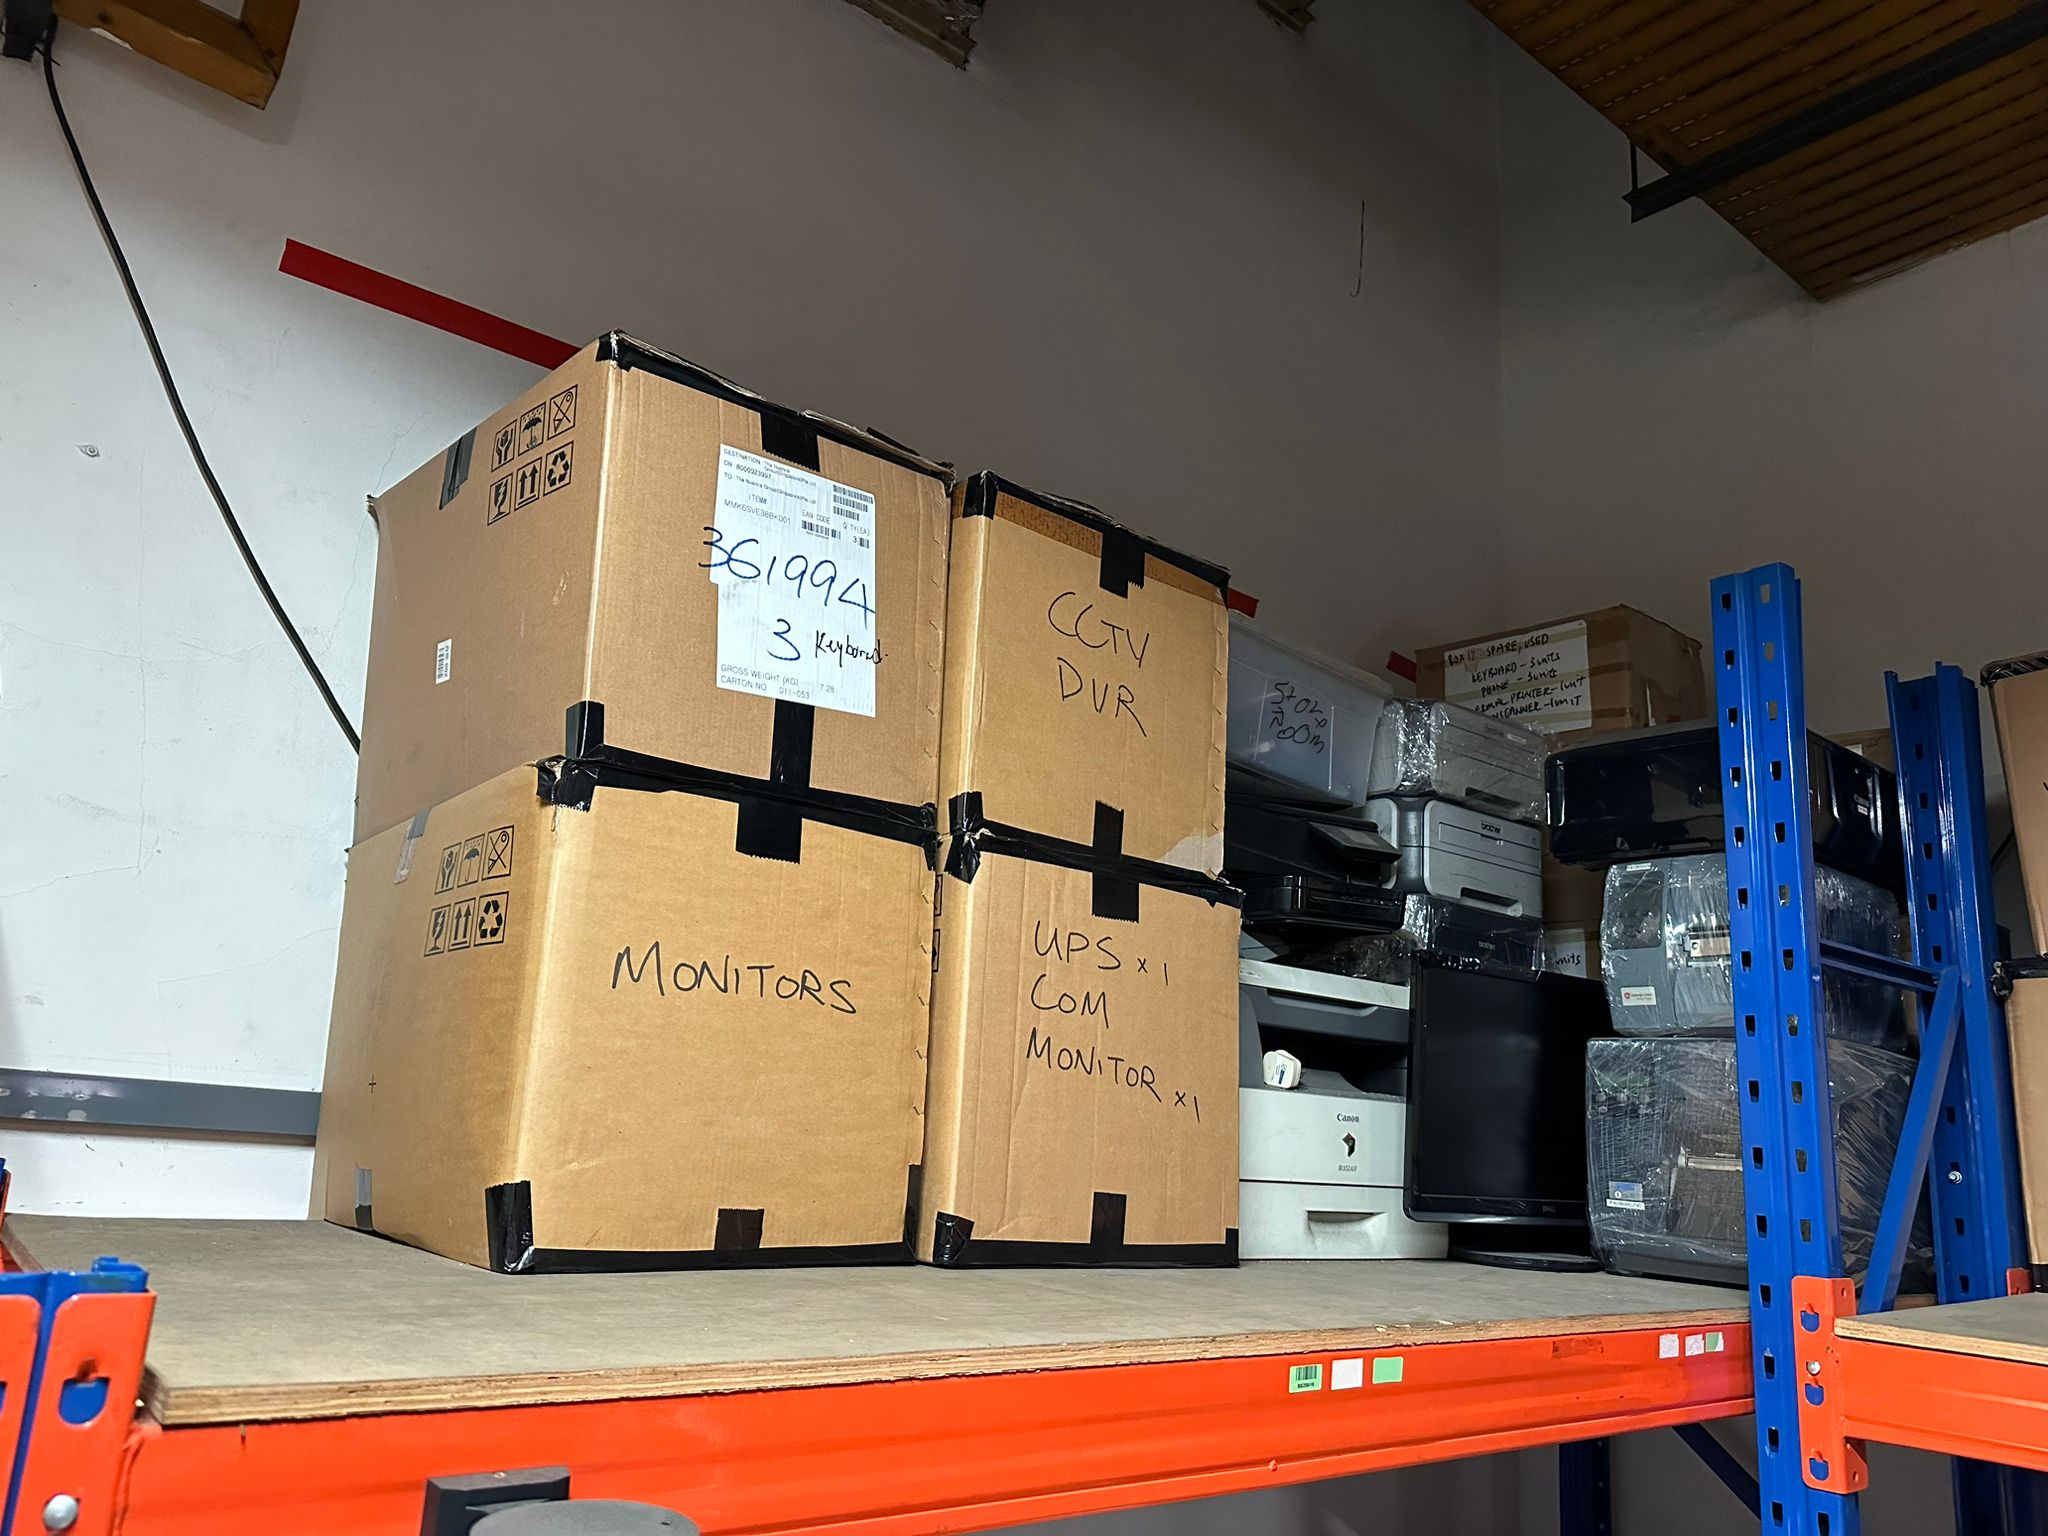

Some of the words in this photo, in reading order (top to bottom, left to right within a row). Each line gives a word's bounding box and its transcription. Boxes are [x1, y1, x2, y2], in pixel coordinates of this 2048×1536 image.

[698, 526, 877, 630] 361994
[766, 618, 801, 662] 3
[1048, 591, 1150, 668] CCTV
[1448, 653, 1465, 666] BOX
[1524, 633, 1549, 649] USED
[720, 664, 749, 676] GROSS
[750, 669, 780, 683] WEIGHT
[720, 675, 753, 688] CARTON
[1471, 661, 1517, 684] KEYBOARD
[1480, 679, 1509, 698] PHONE
[1056, 656, 1147, 738] DVR
[1034, 920, 1122, 970] UPS
[611, 940, 857, 1014] MONITORS
[1031, 973, 1109, 1029] COM
[1026, 1027, 1162, 1103] MONITOR
[1336, 1112, 1360, 1123] Canon
